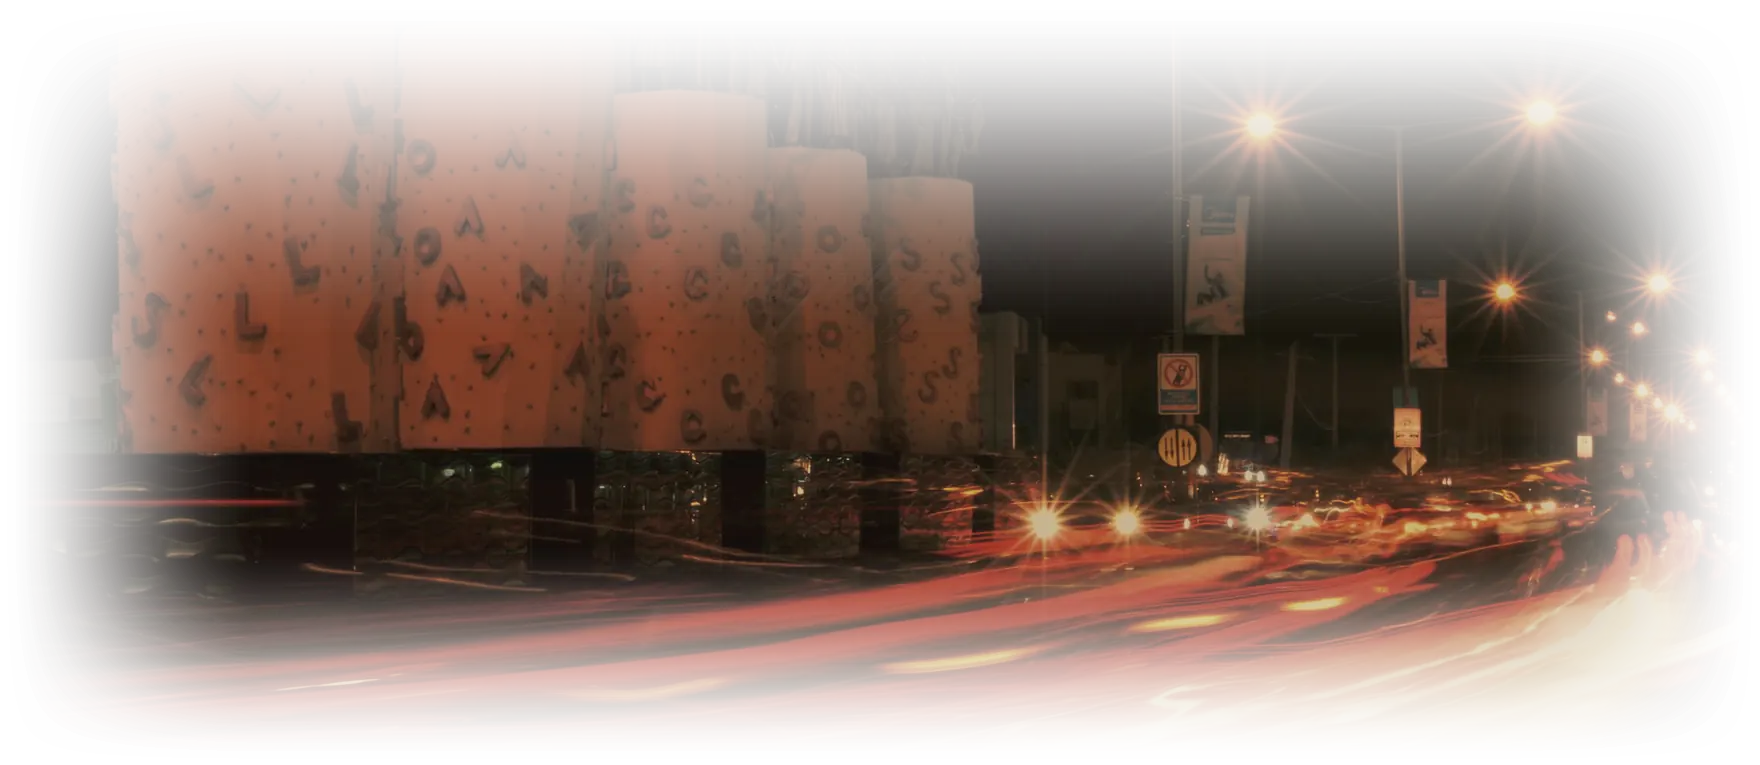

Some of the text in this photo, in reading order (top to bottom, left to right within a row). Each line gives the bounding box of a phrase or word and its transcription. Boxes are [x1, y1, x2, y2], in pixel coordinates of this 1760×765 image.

[283, 237, 321, 291] L
[236, 291, 267, 347] L
[929, 281, 951, 315] S
[918, 370, 940, 405] S
